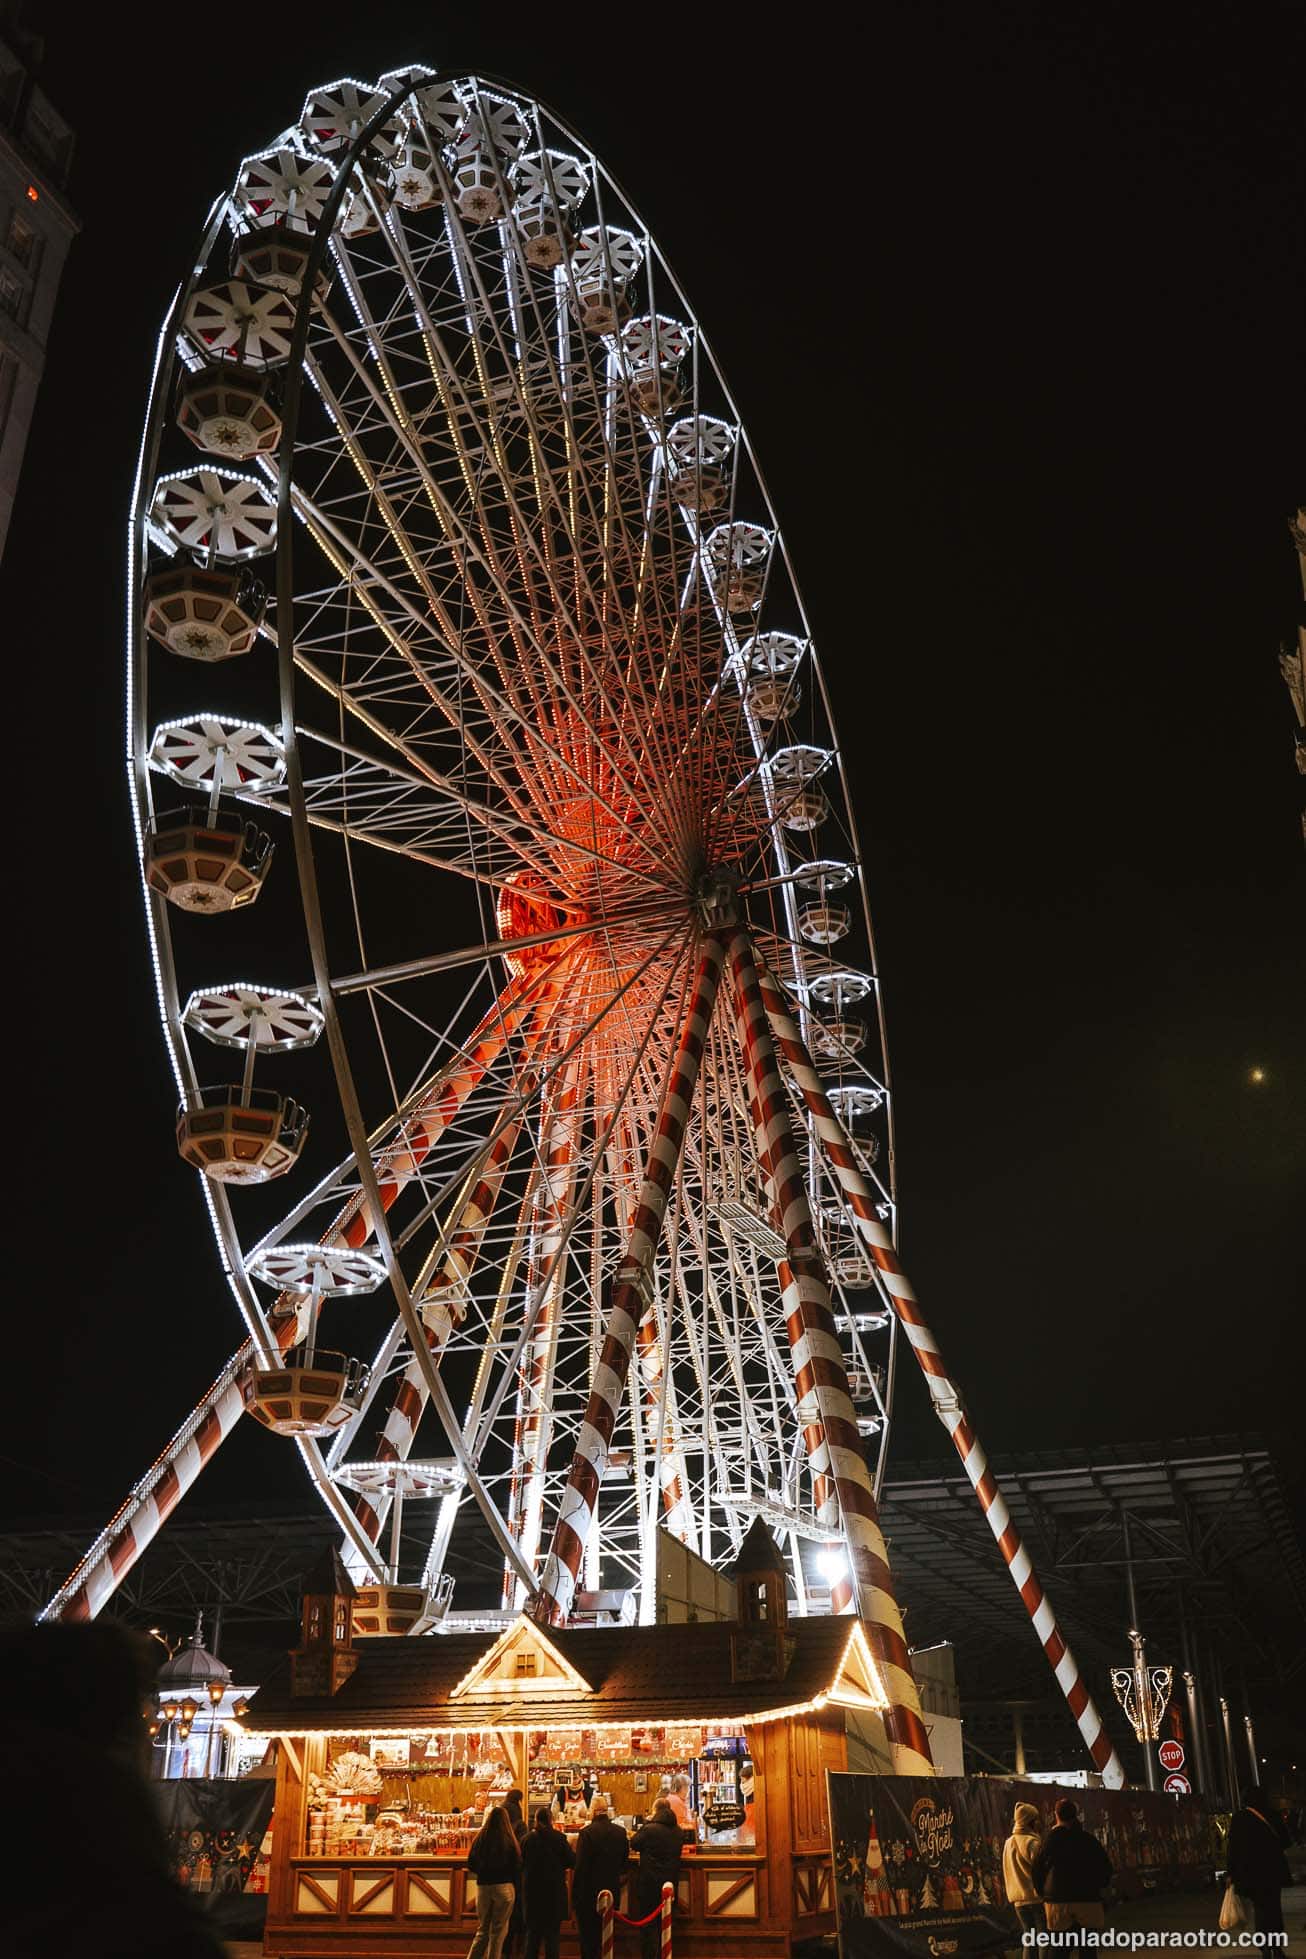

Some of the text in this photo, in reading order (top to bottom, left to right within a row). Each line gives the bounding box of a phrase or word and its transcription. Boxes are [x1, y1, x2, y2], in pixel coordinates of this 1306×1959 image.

[1162, 1750, 1180, 1761] STOP
[918, 1805, 954, 1838] Marché
[927, 1827, 954, 1859] Noël
